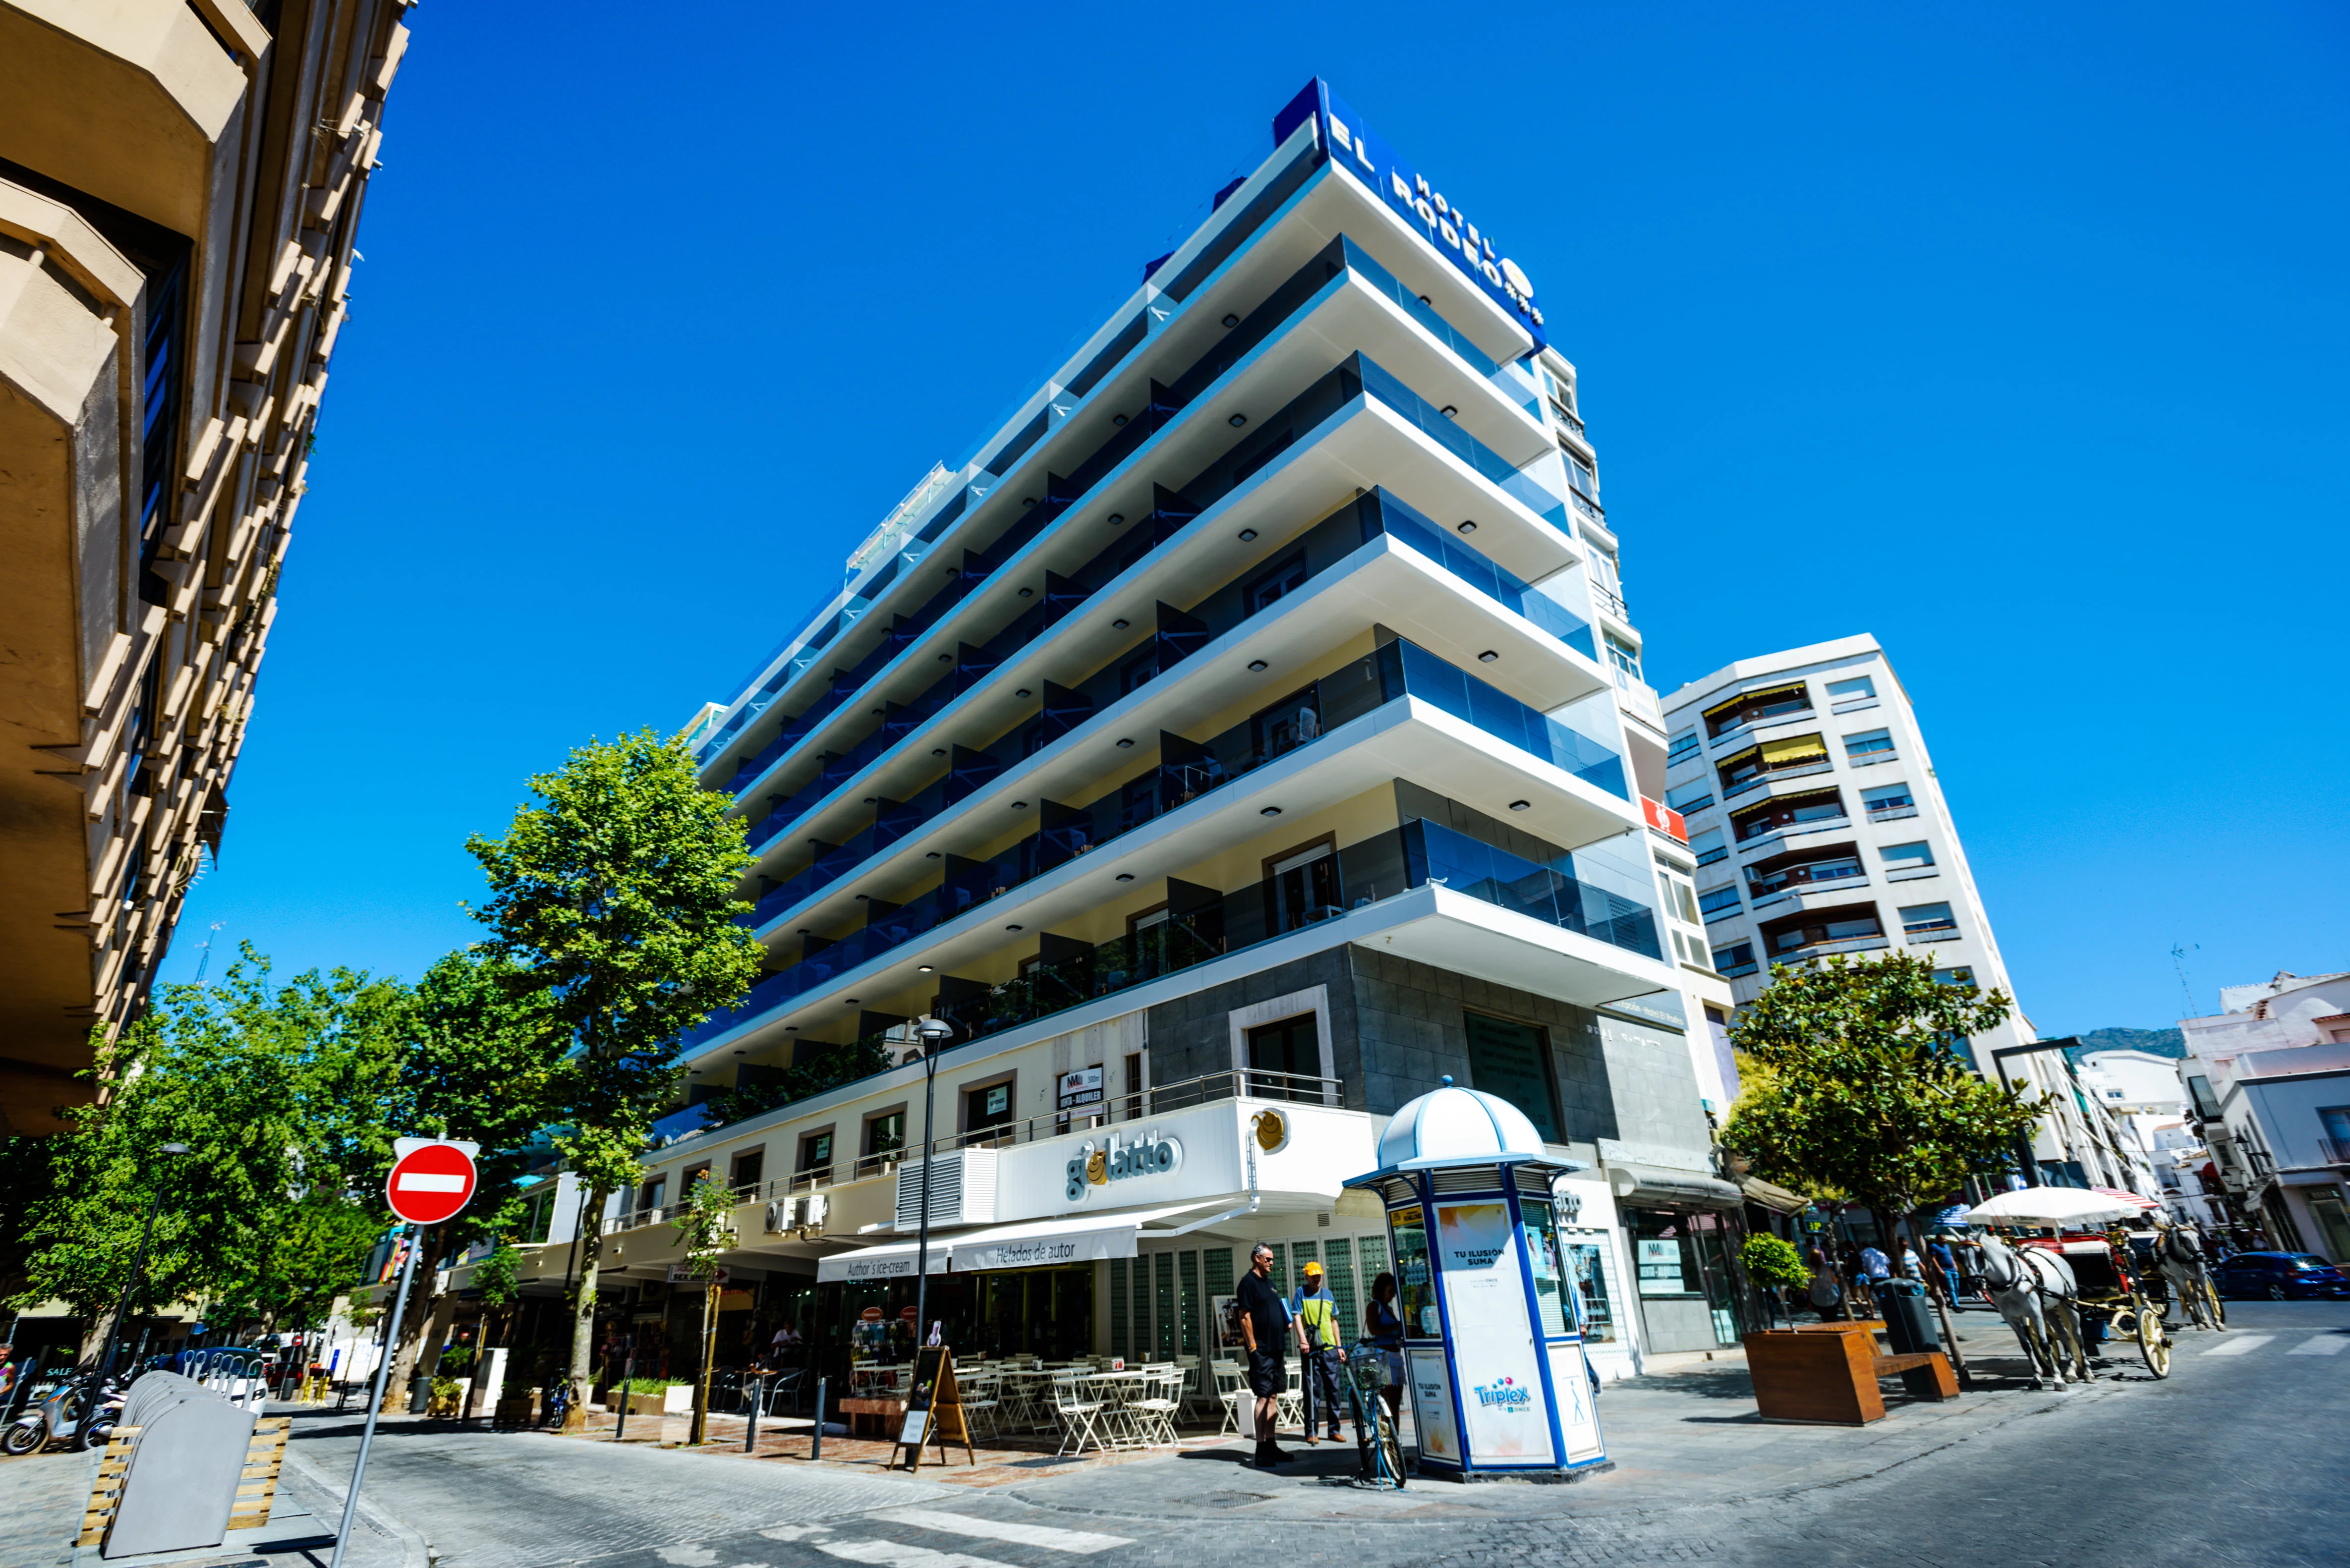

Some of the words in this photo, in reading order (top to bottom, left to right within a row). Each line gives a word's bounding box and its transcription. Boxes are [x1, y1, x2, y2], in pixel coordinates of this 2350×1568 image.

[1329, 112, 1375, 172] EL
[1391, 170, 1502, 288] RODEO
[1416, 173, 1495, 260] HOTEL
[1644, 1007, 1659, 1019] Hotel
[1076, 1091, 1101, 1104] ALQUILER
[996, 1245, 1032, 1264] Helados
[1034, 1242, 1045, 1260] de
[1048, 1242, 1075, 1259] autor
[1469, 1248, 1504, 1257] ILUSIÓN
[876, 1260, 910, 1274] ice-cream
[1474, 1385, 1529, 1405] Triplex
